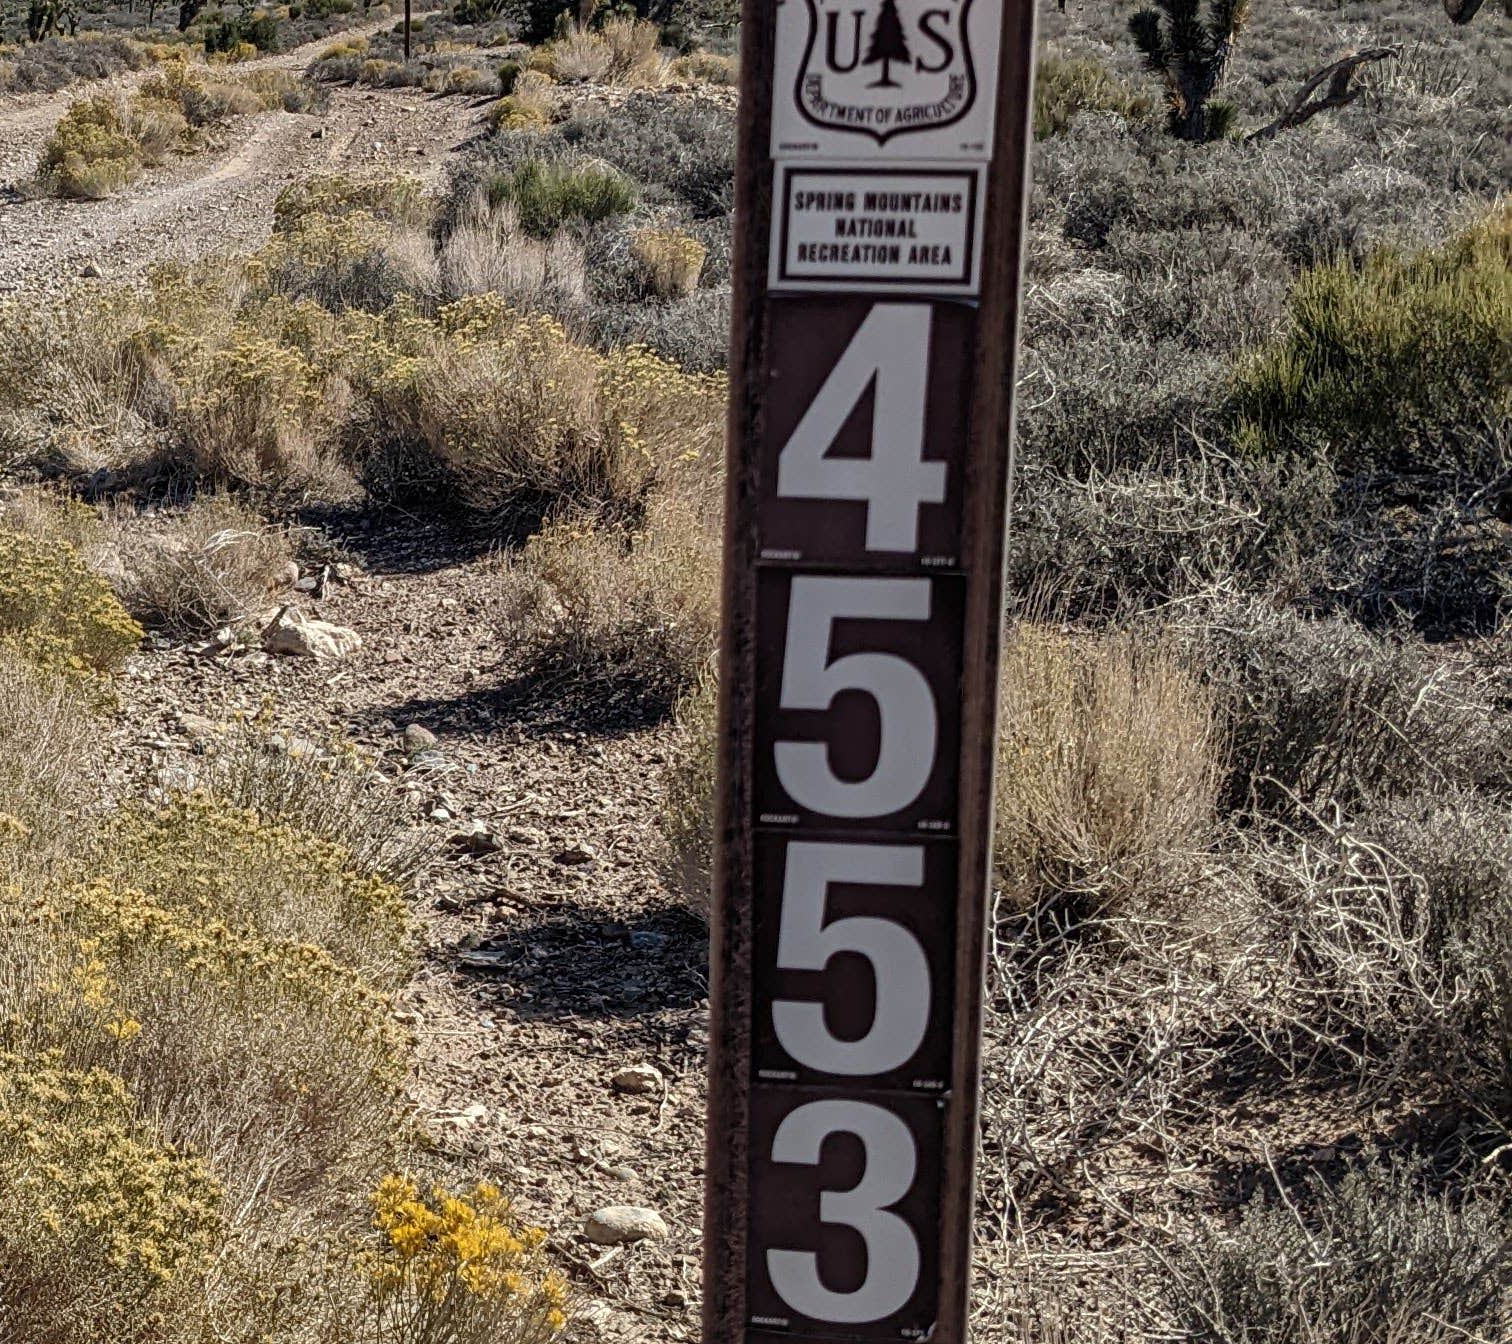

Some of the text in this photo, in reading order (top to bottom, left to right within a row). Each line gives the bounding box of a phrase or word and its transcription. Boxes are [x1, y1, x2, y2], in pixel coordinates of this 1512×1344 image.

[825, 9, 954, 74] U S
[794, 190, 963, 213] SPRING MOUNTAINS
[835, 217, 917, 238] NATIONAL
[797, 242, 952, 265] RECREATION AREA
